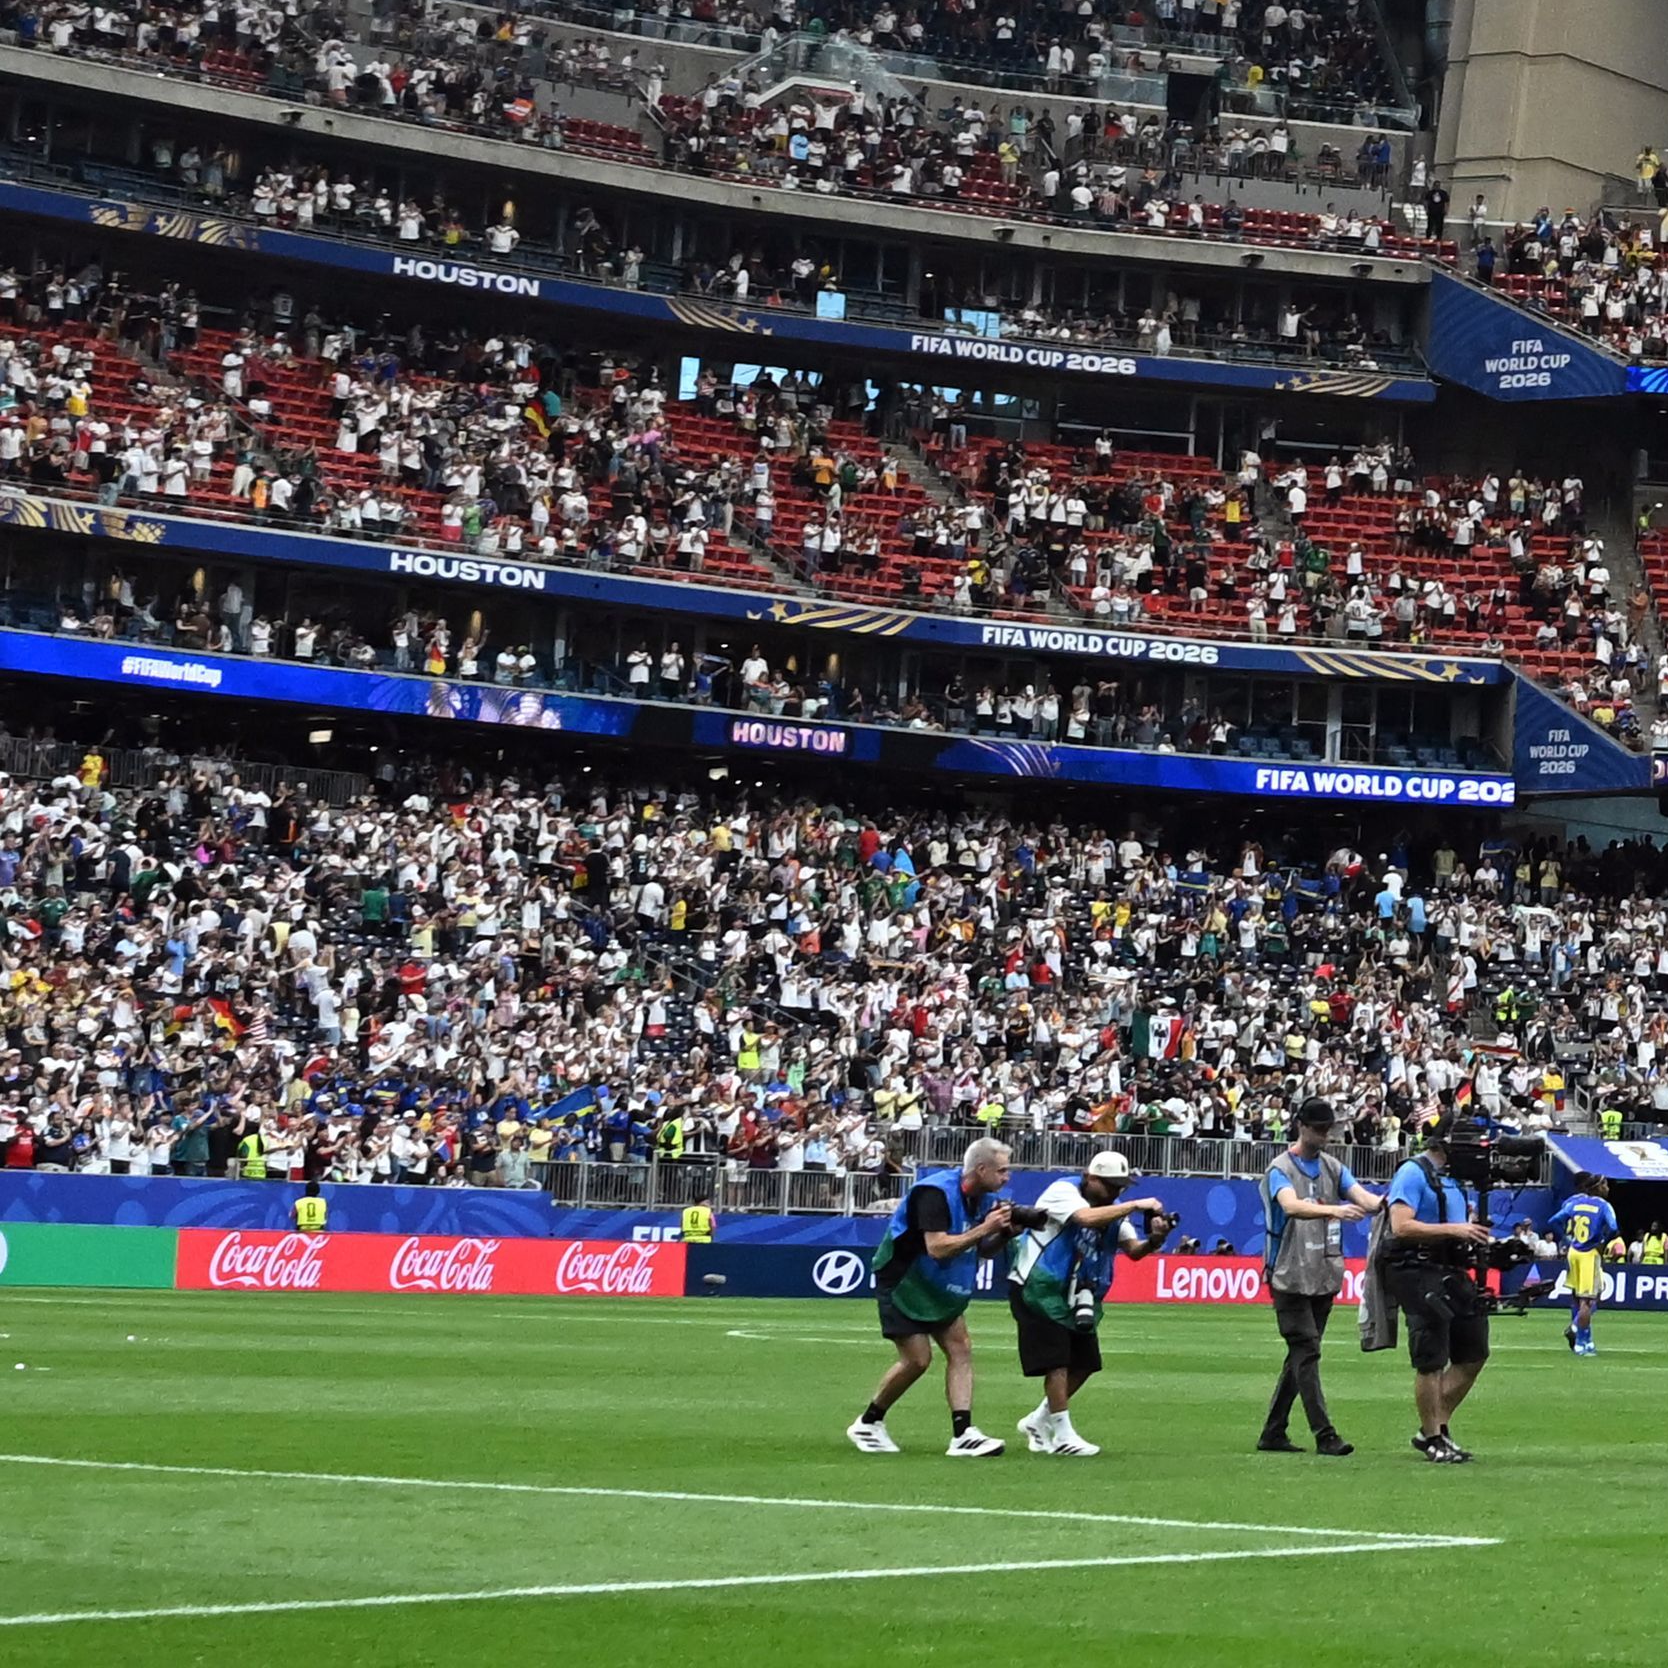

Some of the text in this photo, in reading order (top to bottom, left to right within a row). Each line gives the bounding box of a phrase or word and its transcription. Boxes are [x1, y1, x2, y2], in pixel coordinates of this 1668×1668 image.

[393, 257, 540, 296] HOUSTON
[911, 334, 1137, 375] FIFA WORLD CUP 2026
[1485, 354, 1571, 373] WORLD CUP
[1512, 339, 1543, 354] FIFA
[1499, 372, 1551, 388] 2026
[390, 552, 545, 589] HOUSTON
[982, 626, 1219, 665] FIFA WORLD CUP 2026
[733, 721, 846, 752] HOUSTON
[1529, 744, 1589, 759] WORLD CUP
[1548, 729, 1571, 742] FIFA
[1256, 769, 1311, 793] FIFA
[1312, 772, 1403, 798] WORLD
[1406, 777, 1456, 800] CUP
[1539, 760, 1576, 775] 2026
[208, 1231, 330, 1289] Coca-Cola
[389, 1236, 500, 1290] Coca-Cola
[556, 1241, 661, 1293] Coca-Cola
[1156, 1258, 1260, 1300] Lenovo
